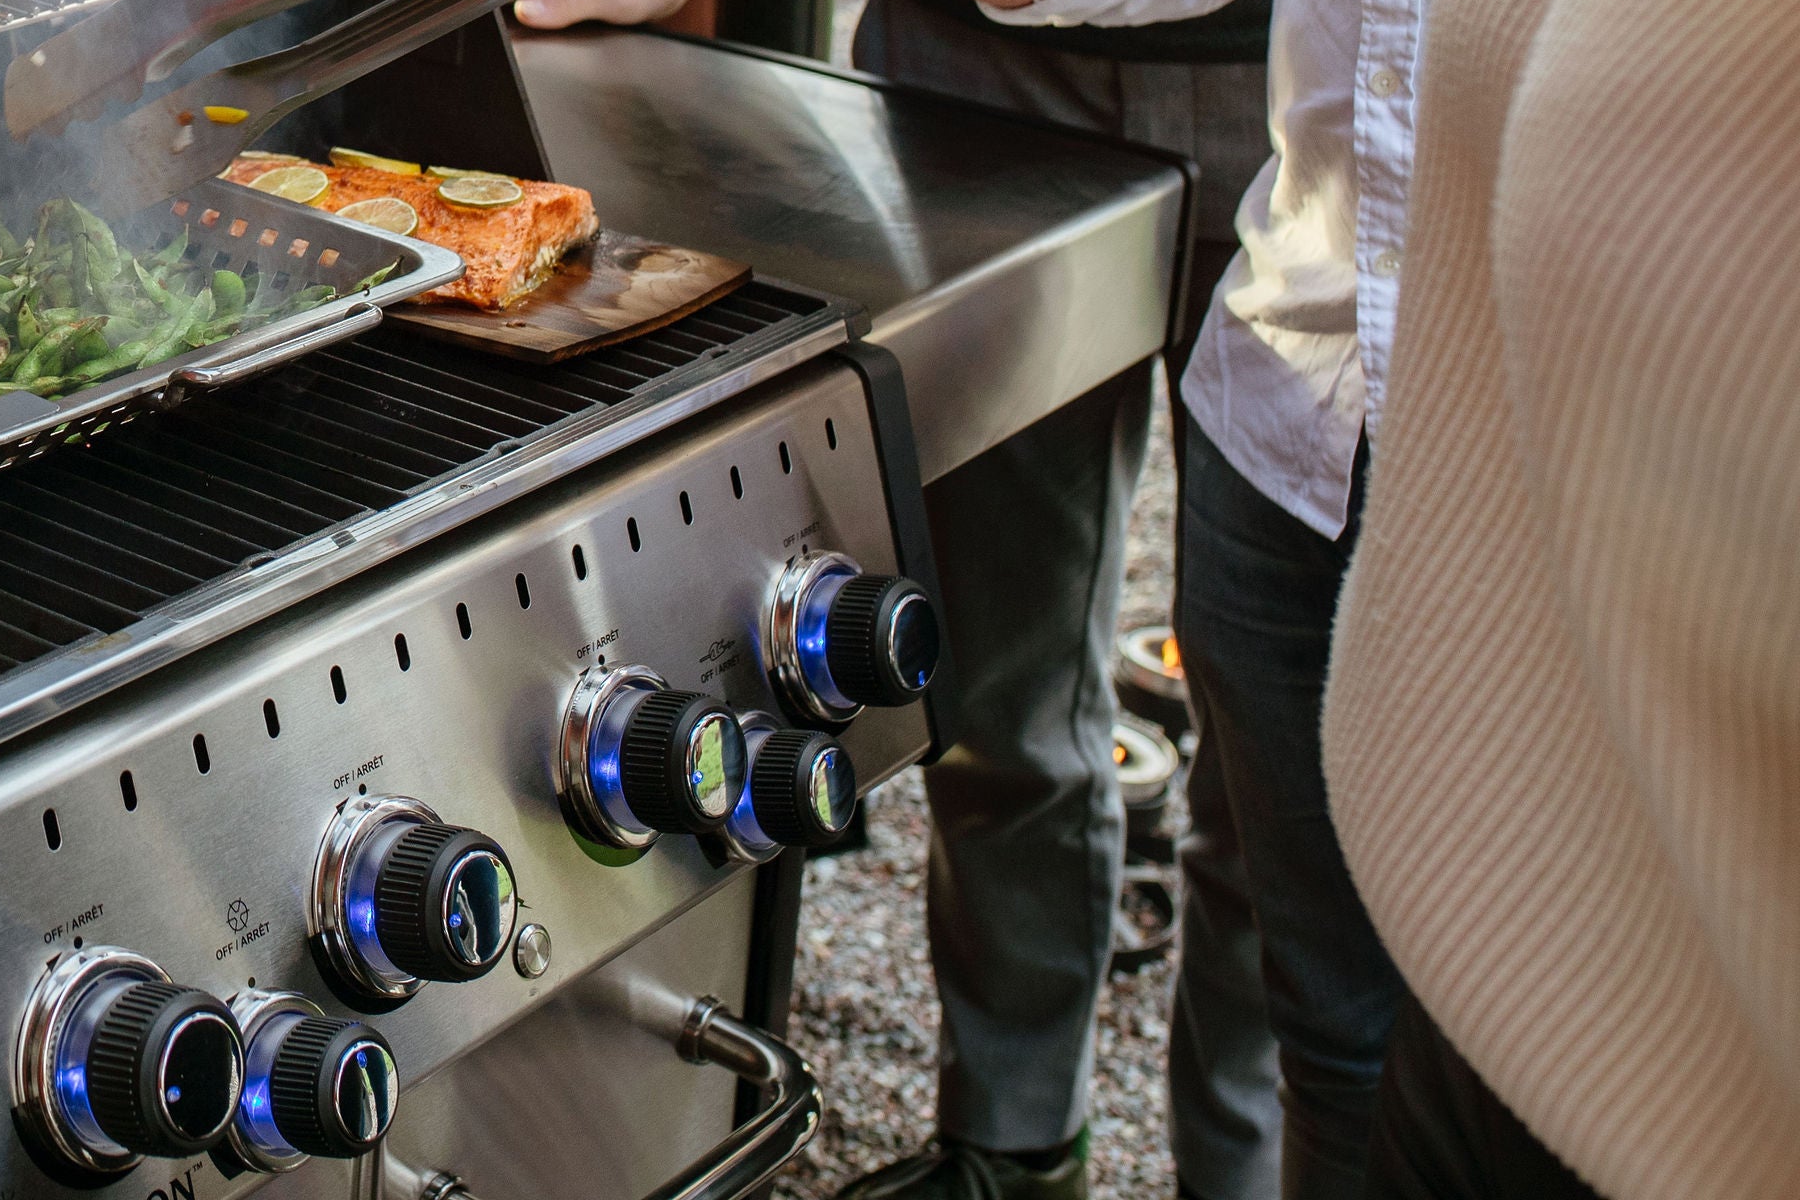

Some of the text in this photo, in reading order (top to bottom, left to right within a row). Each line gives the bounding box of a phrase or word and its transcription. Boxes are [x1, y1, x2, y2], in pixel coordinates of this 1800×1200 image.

[576, 644, 591, 659] OFF
[596, 629, 619, 650] ARRÊT
[333, 773, 350, 790] OFF
[356, 754, 384, 779] ARRÊT
[43, 925, 63, 944] OFF
[71, 903, 104, 931] ARRÊT
[215, 942, 234, 961] OFF
[240, 921, 270, 948] ARRÊT
